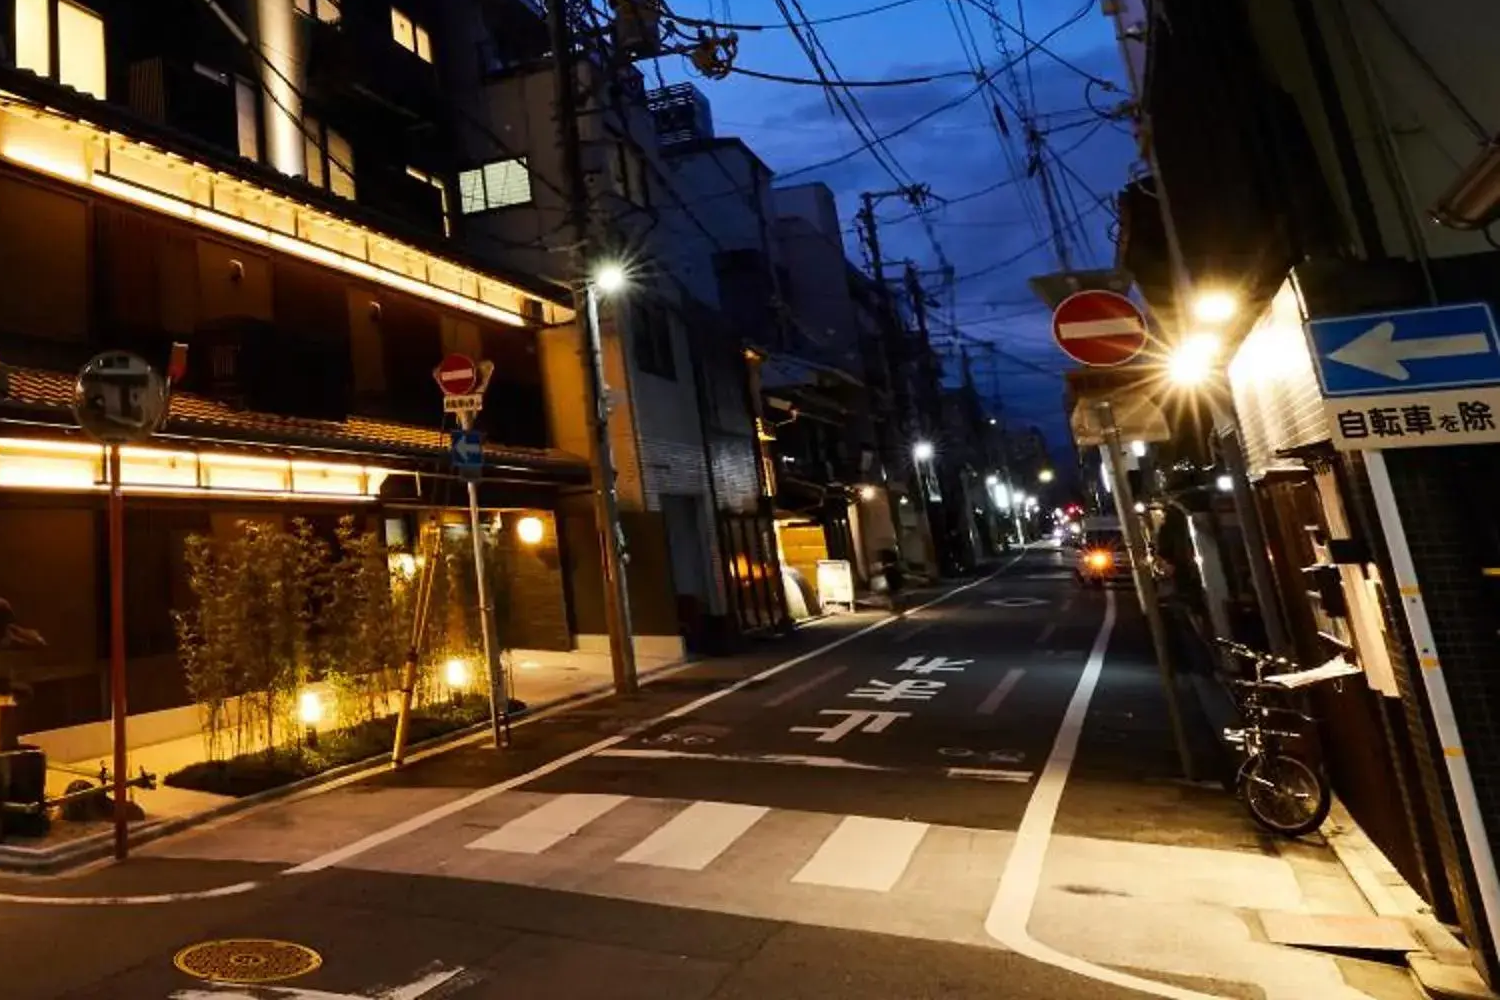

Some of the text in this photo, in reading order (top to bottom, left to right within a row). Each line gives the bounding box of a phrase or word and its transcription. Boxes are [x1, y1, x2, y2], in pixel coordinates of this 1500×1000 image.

[1337, 400, 1496, 438] 自転車を除
